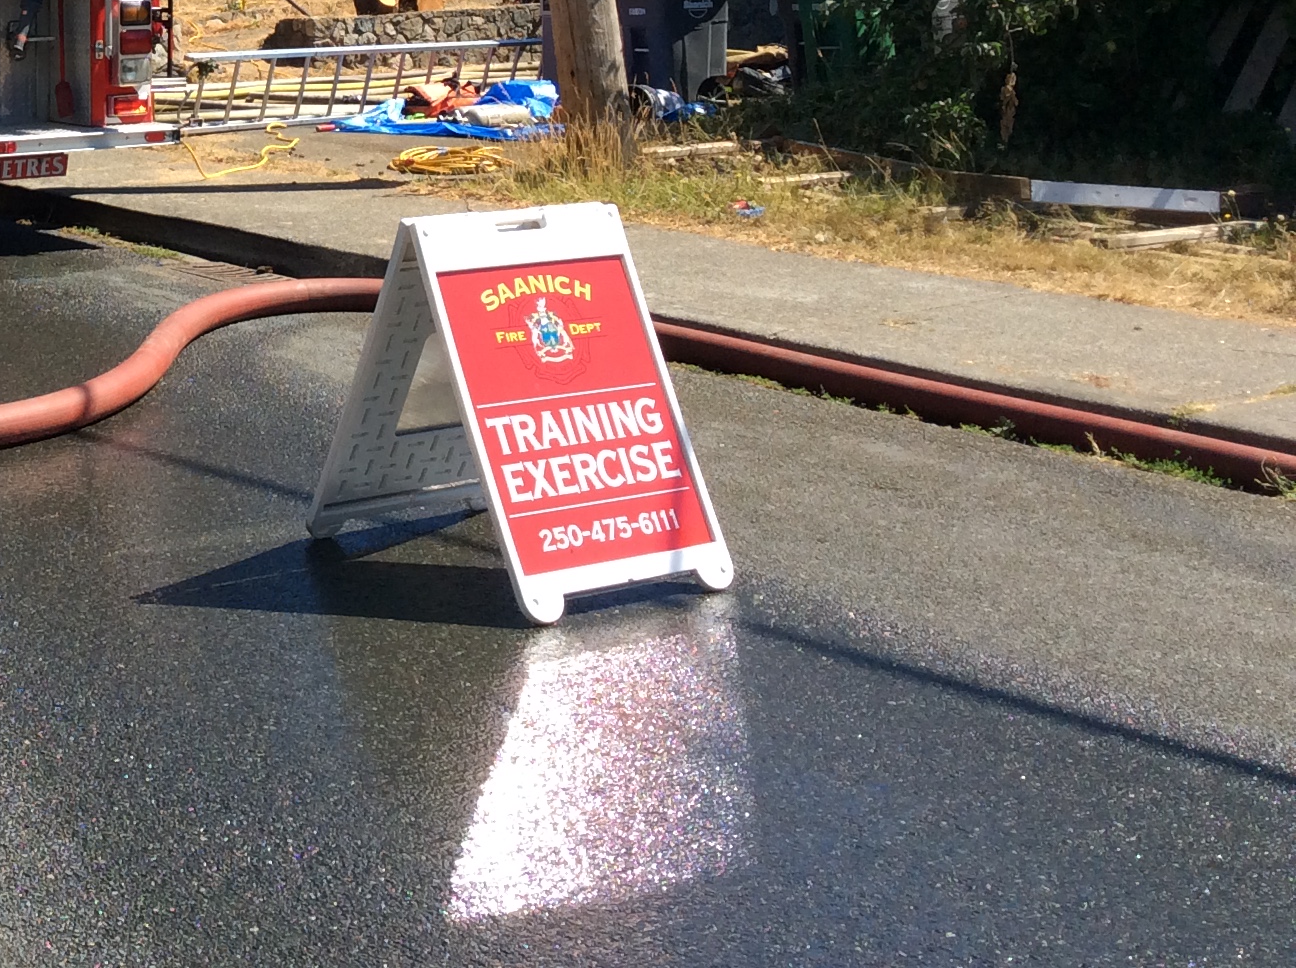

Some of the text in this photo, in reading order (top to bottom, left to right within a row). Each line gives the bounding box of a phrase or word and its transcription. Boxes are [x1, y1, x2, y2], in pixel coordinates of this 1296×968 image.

[480, 274, 592, 312] SAANICH
[495, 322, 602, 343] FIRE DEPT
[485, 397, 664, 455] TRAINING
[500, 440, 683, 503] EXERCISE
[538, 508, 681, 553] 250-475-6111
